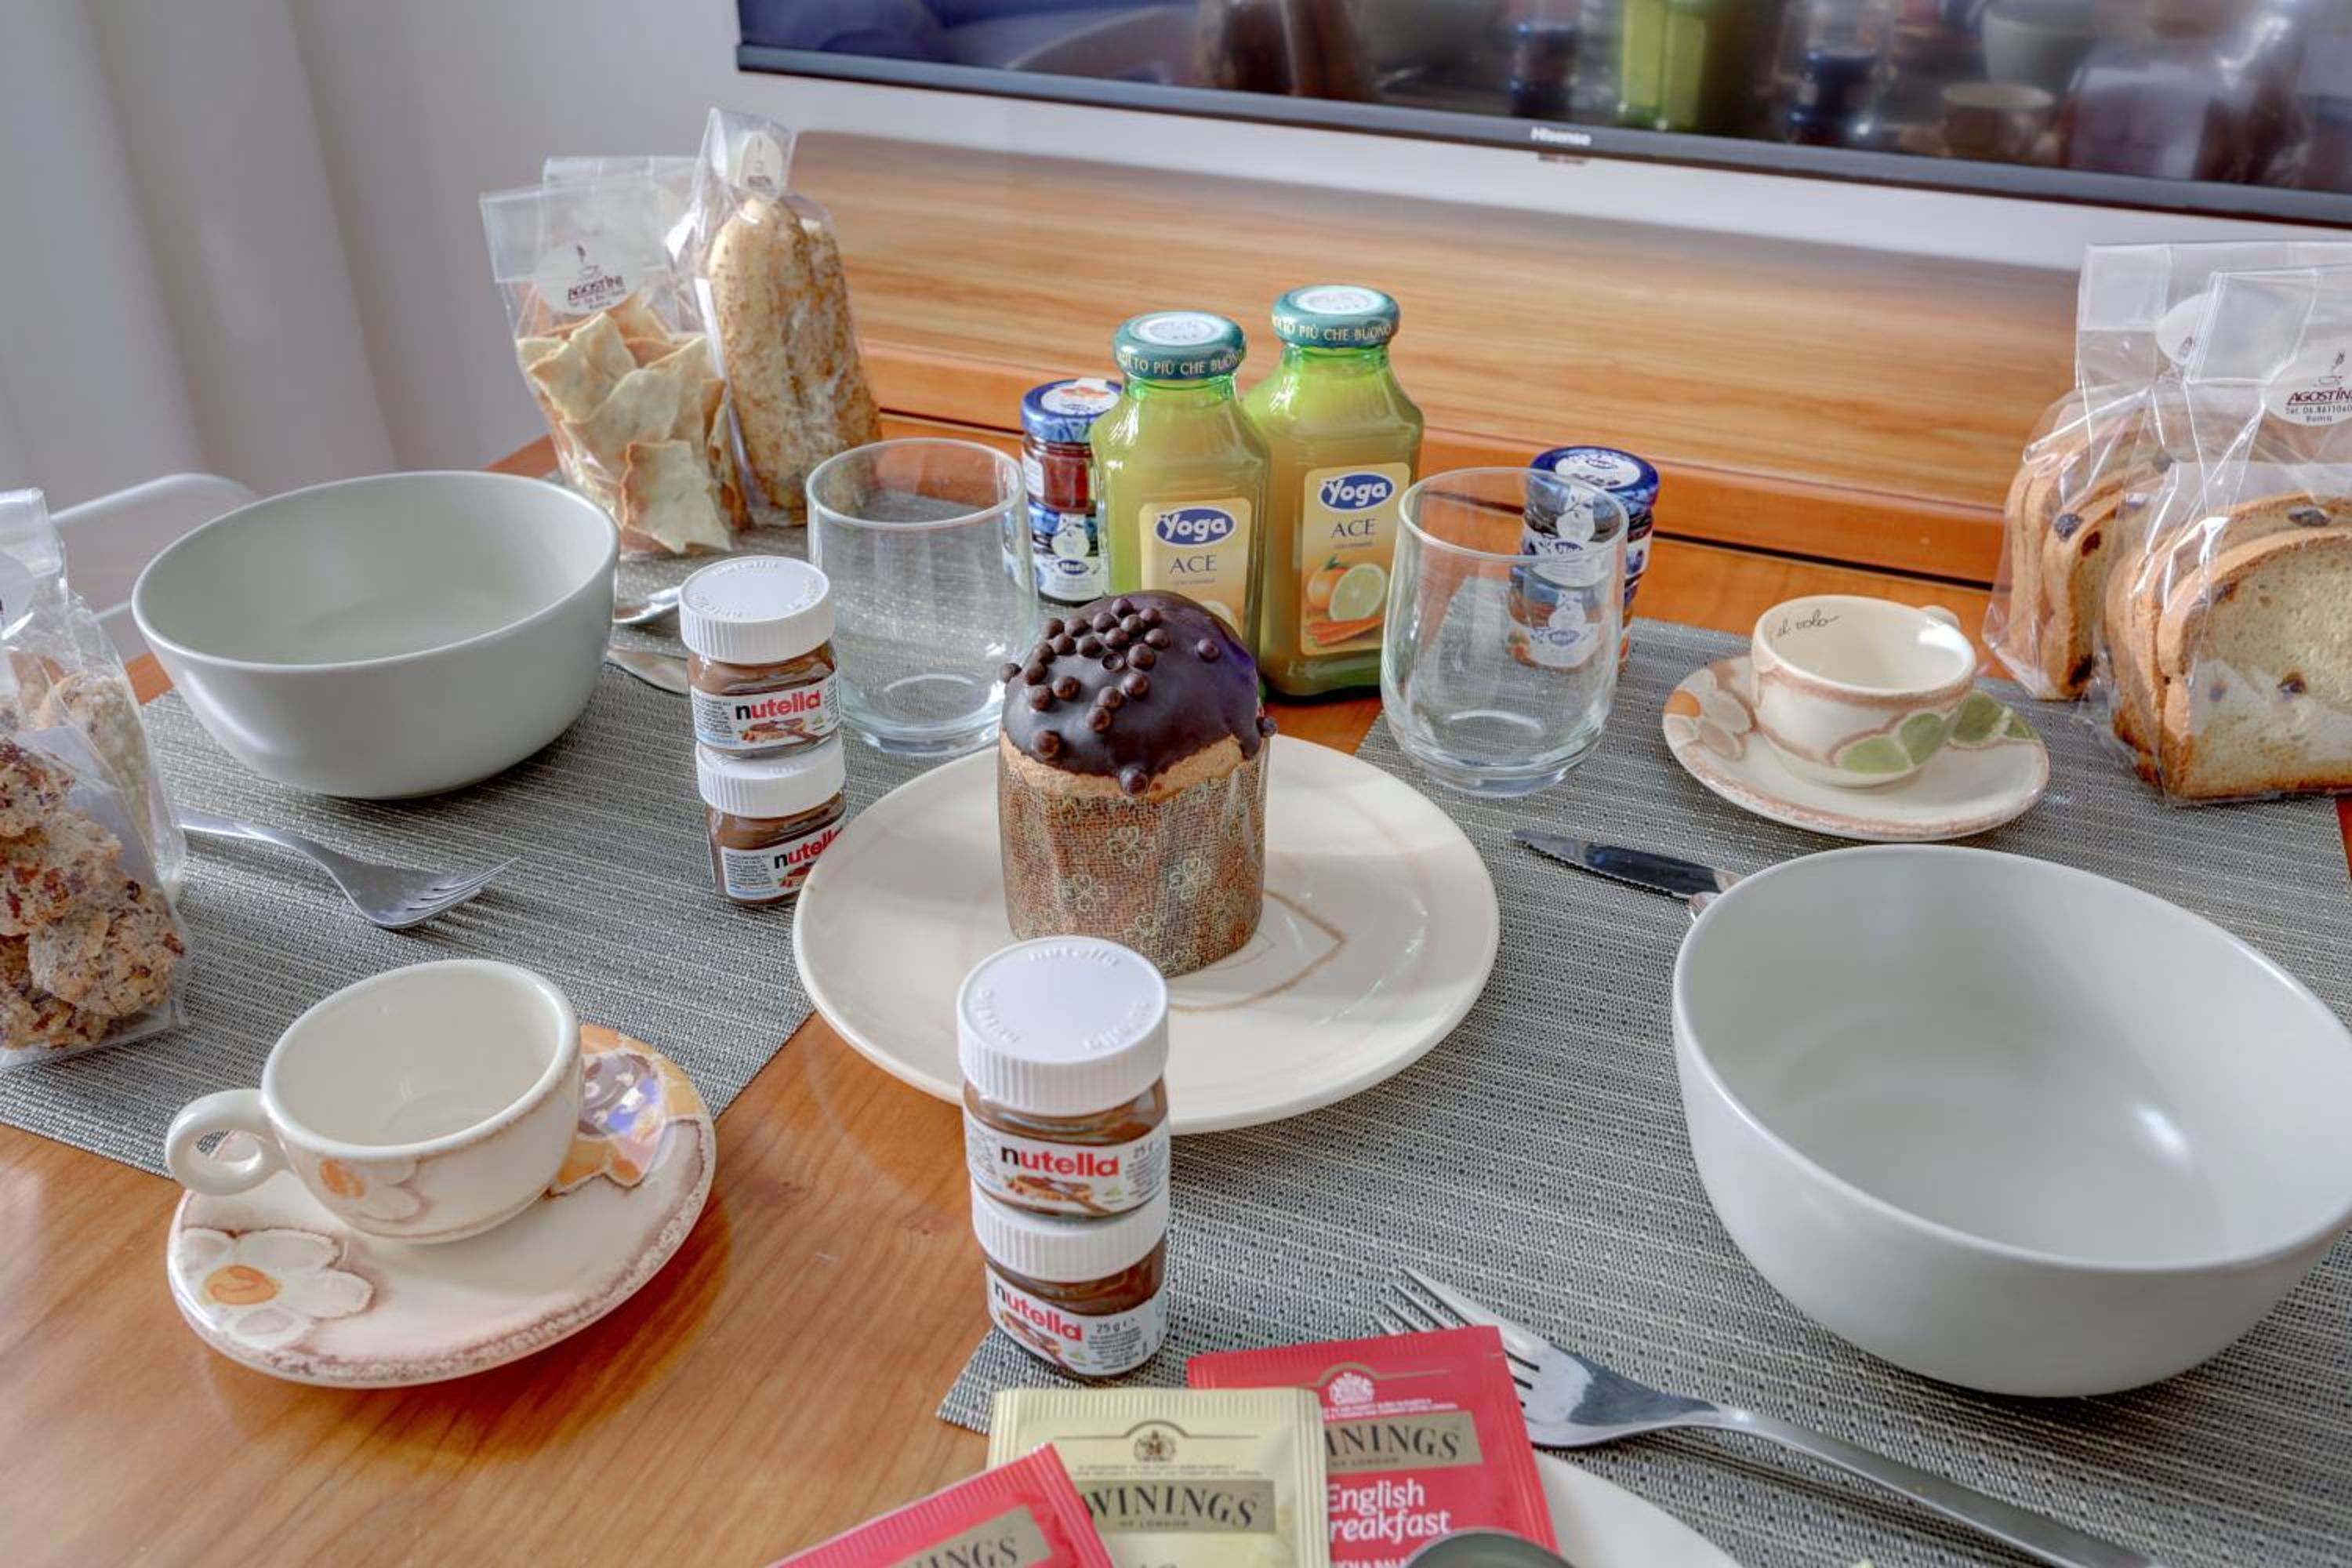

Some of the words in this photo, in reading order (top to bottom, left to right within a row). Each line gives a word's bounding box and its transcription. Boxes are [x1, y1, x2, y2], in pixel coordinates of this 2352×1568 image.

[1323, 328, 1350, 342] CHE
[1354, 324, 1392, 341] BUONO
[1180, 361, 1205, 376] CHE
[1325, 479, 1388, 507] Yoga
[1160, 514, 1228, 542] Yoga
[1331, 518, 1377, 539] ACE
[1169, 554, 1218, 575] ACE
[735, 690, 822, 720] nutella
[774, 827, 844, 869] nutell
[1000, 1145, 1120, 1177] nutella
[995, 1281, 1082, 1341] nutella
[1325, 1425, 1461, 1460] ININGS
[1081, 1485, 1258, 1528] WININGS
[1329, 1508, 1452, 1545] reakfast
